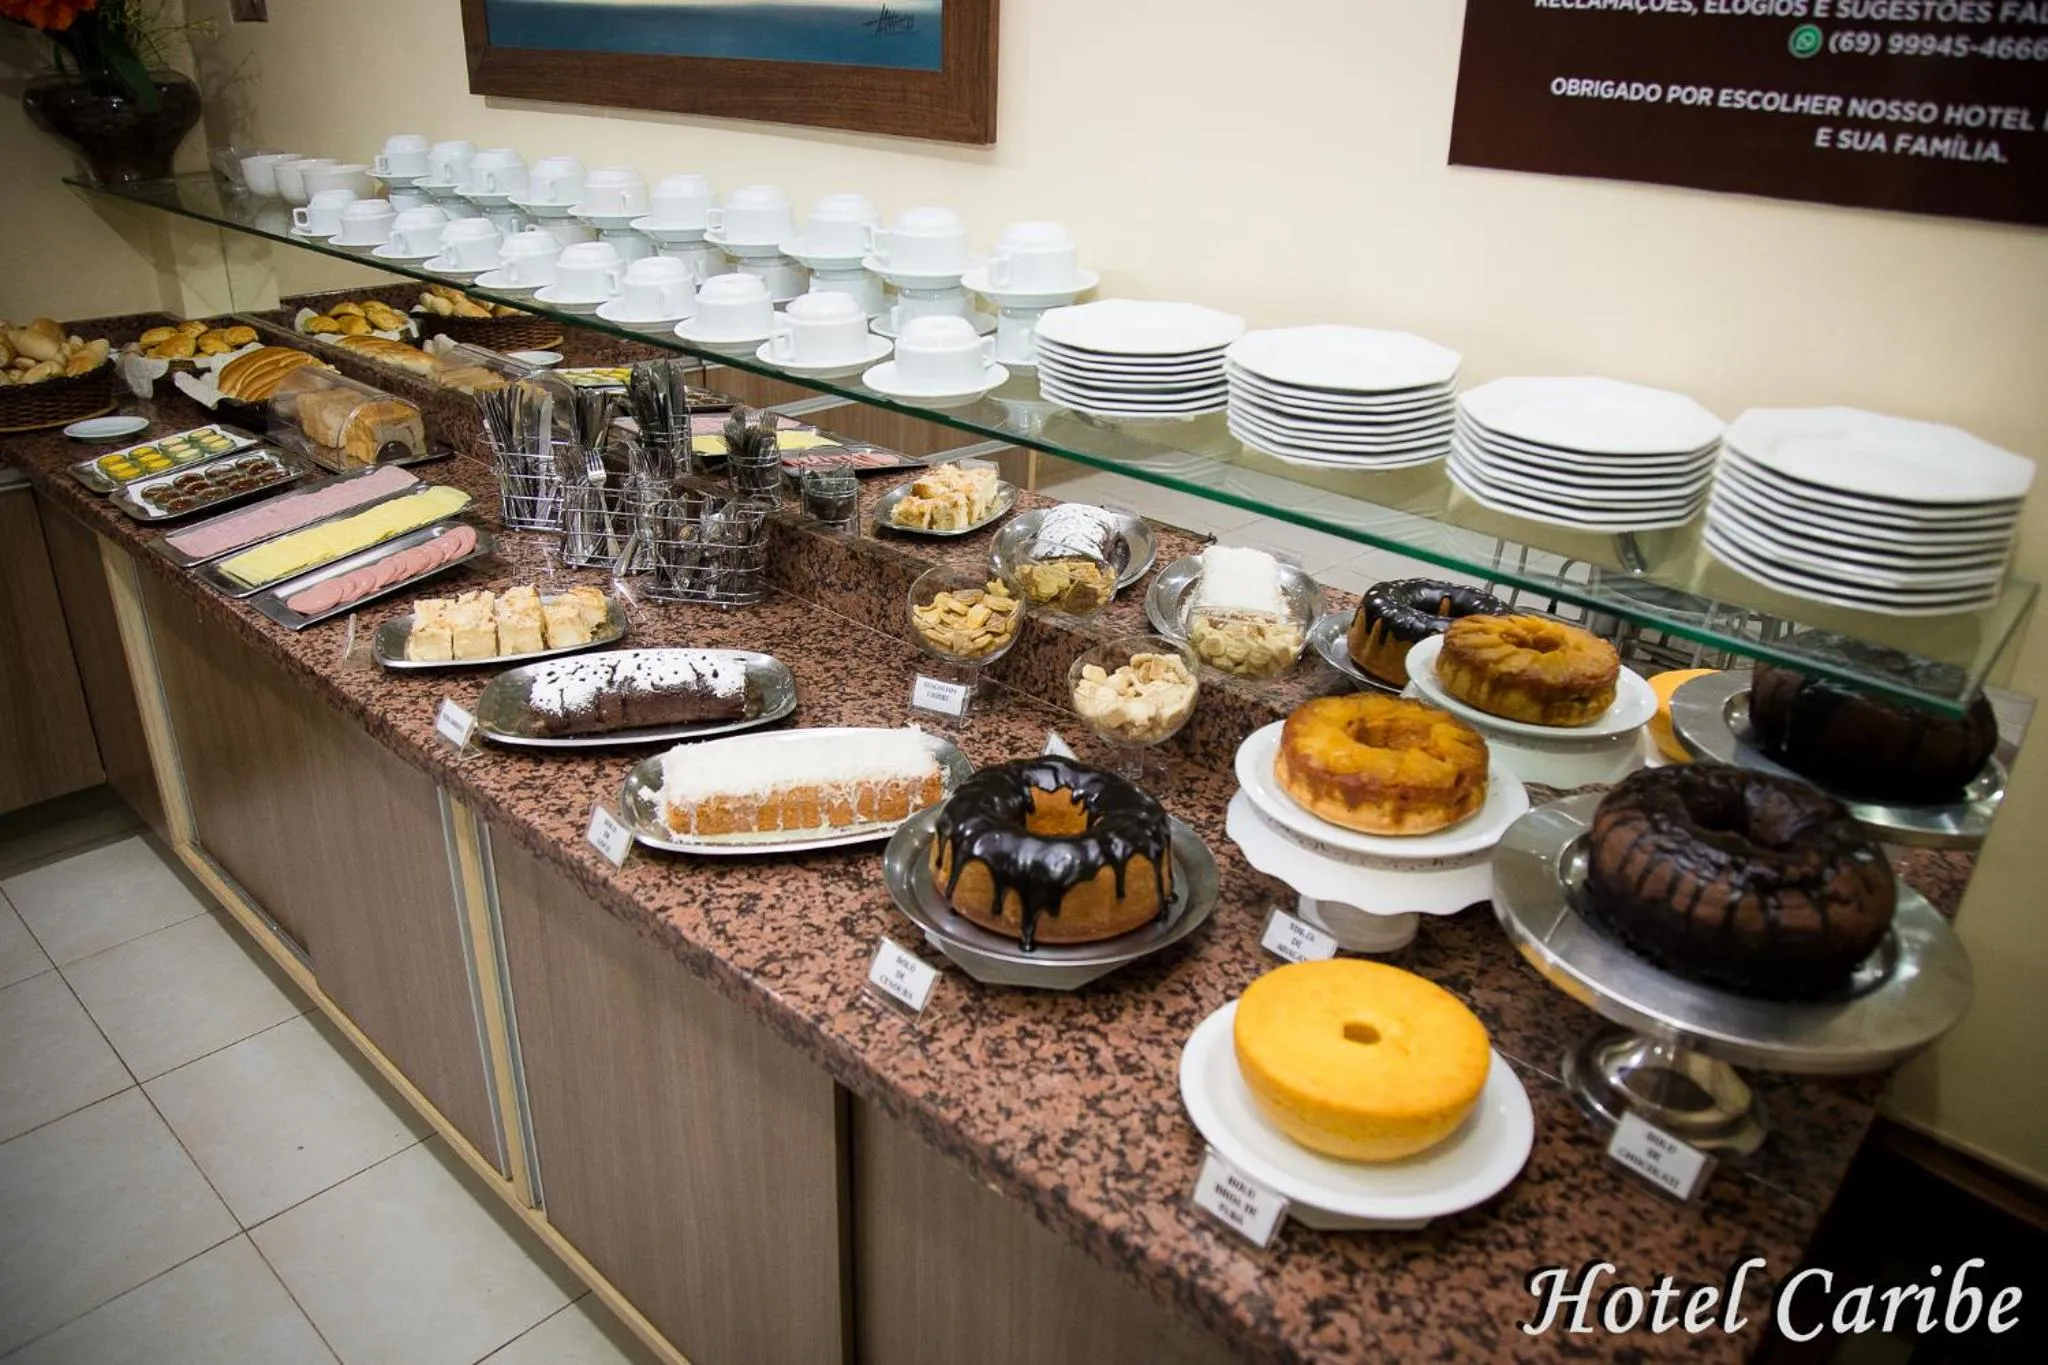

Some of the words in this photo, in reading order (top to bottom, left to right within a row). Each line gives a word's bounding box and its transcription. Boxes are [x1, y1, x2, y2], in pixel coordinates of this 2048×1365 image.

[1704, 0, 1808, 16] ELOGIOS
[1813, 0, 1830, 18] E
[1828, 31, 1882, 56] (69)
[1886, 33, 2048, 61] 99945-4666
[1550, 77, 1662, 102] OBRIGADO
[1666, 85, 1714, 106] POR
[1717, 89, 1843, 117] ESCOLHER
[1846, 98, 1939, 124] NOSSO
[1943, 104, 2035, 132] HOTEL
[1815, 127, 1833, 148] E
[1836, 130, 1888, 152] SUA
[1893, 133, 2009, 163] FAMÍLIA.
